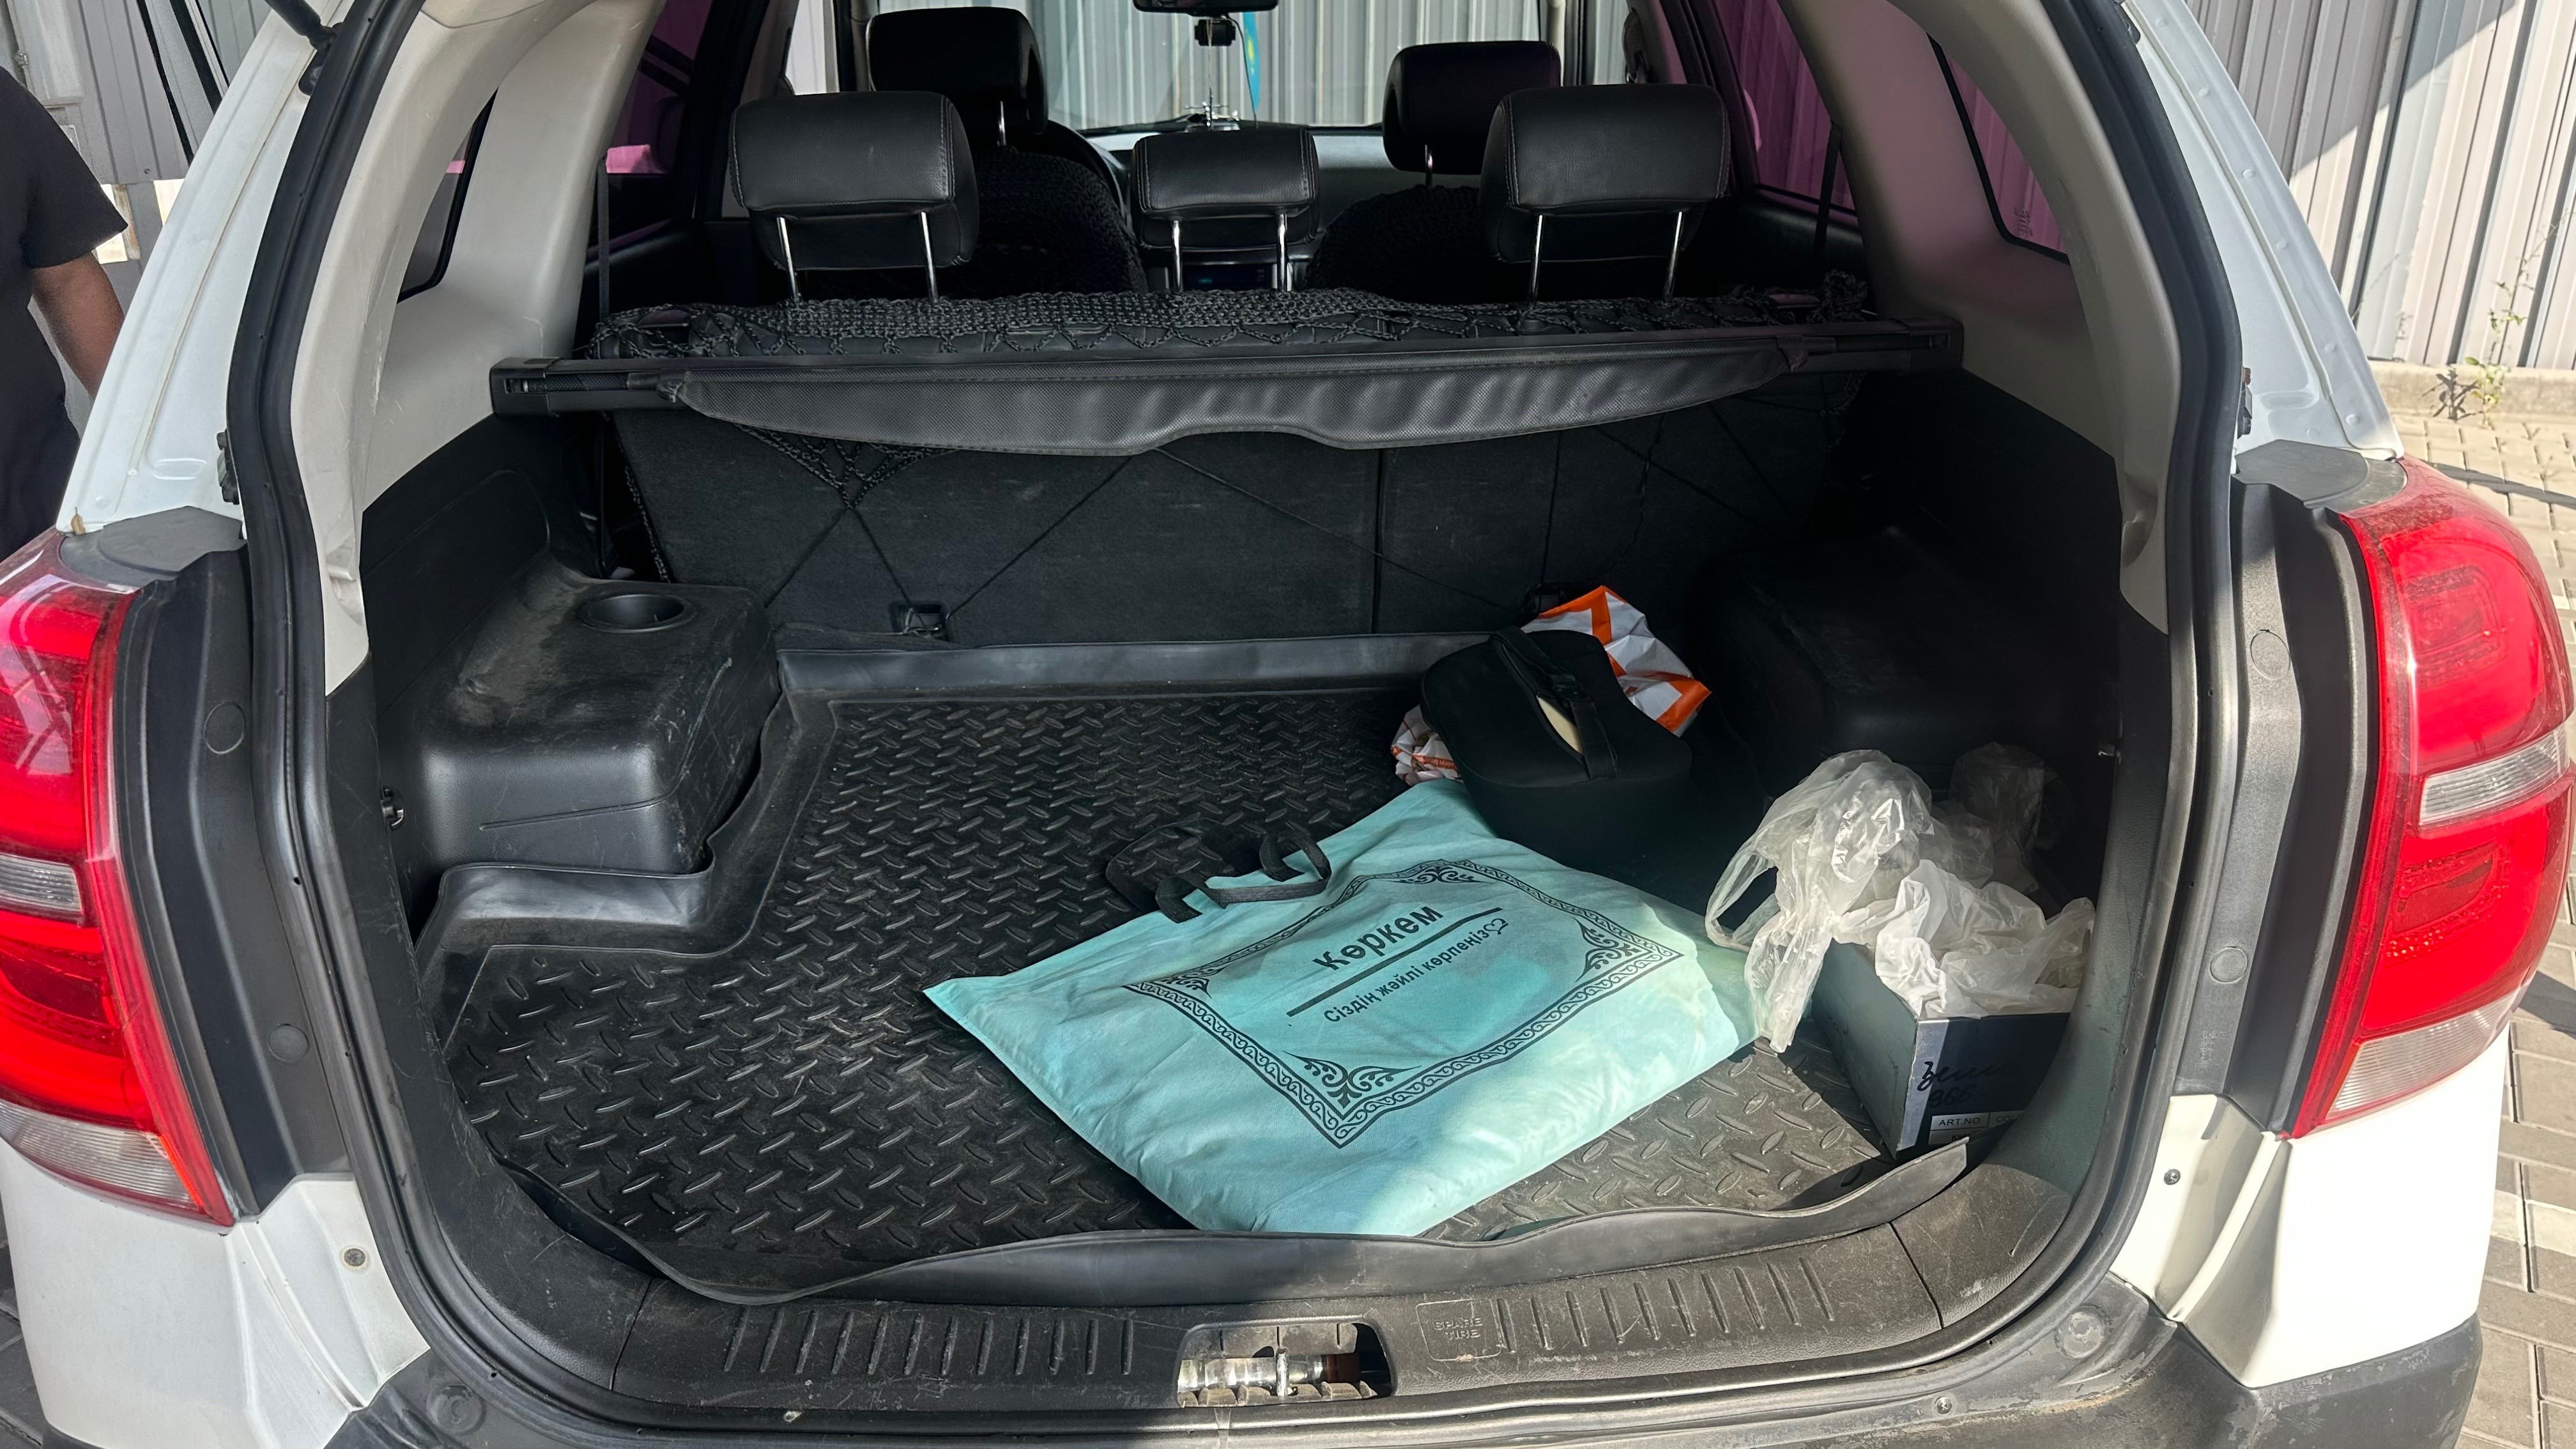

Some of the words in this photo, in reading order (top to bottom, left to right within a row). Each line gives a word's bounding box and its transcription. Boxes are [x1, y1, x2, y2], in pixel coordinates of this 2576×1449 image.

[1312, 906, 1444, 970] Көркем
[1324, 992, 1382, 1022] Сіздің
[1375, 965, 1425, 996] жәйлі
[1422, 930, 1490, 970] көрпеңіз
[1433, 1317, 1483, 1331] SPARE
[1445, 1329, 1481, 1340] TIRE
